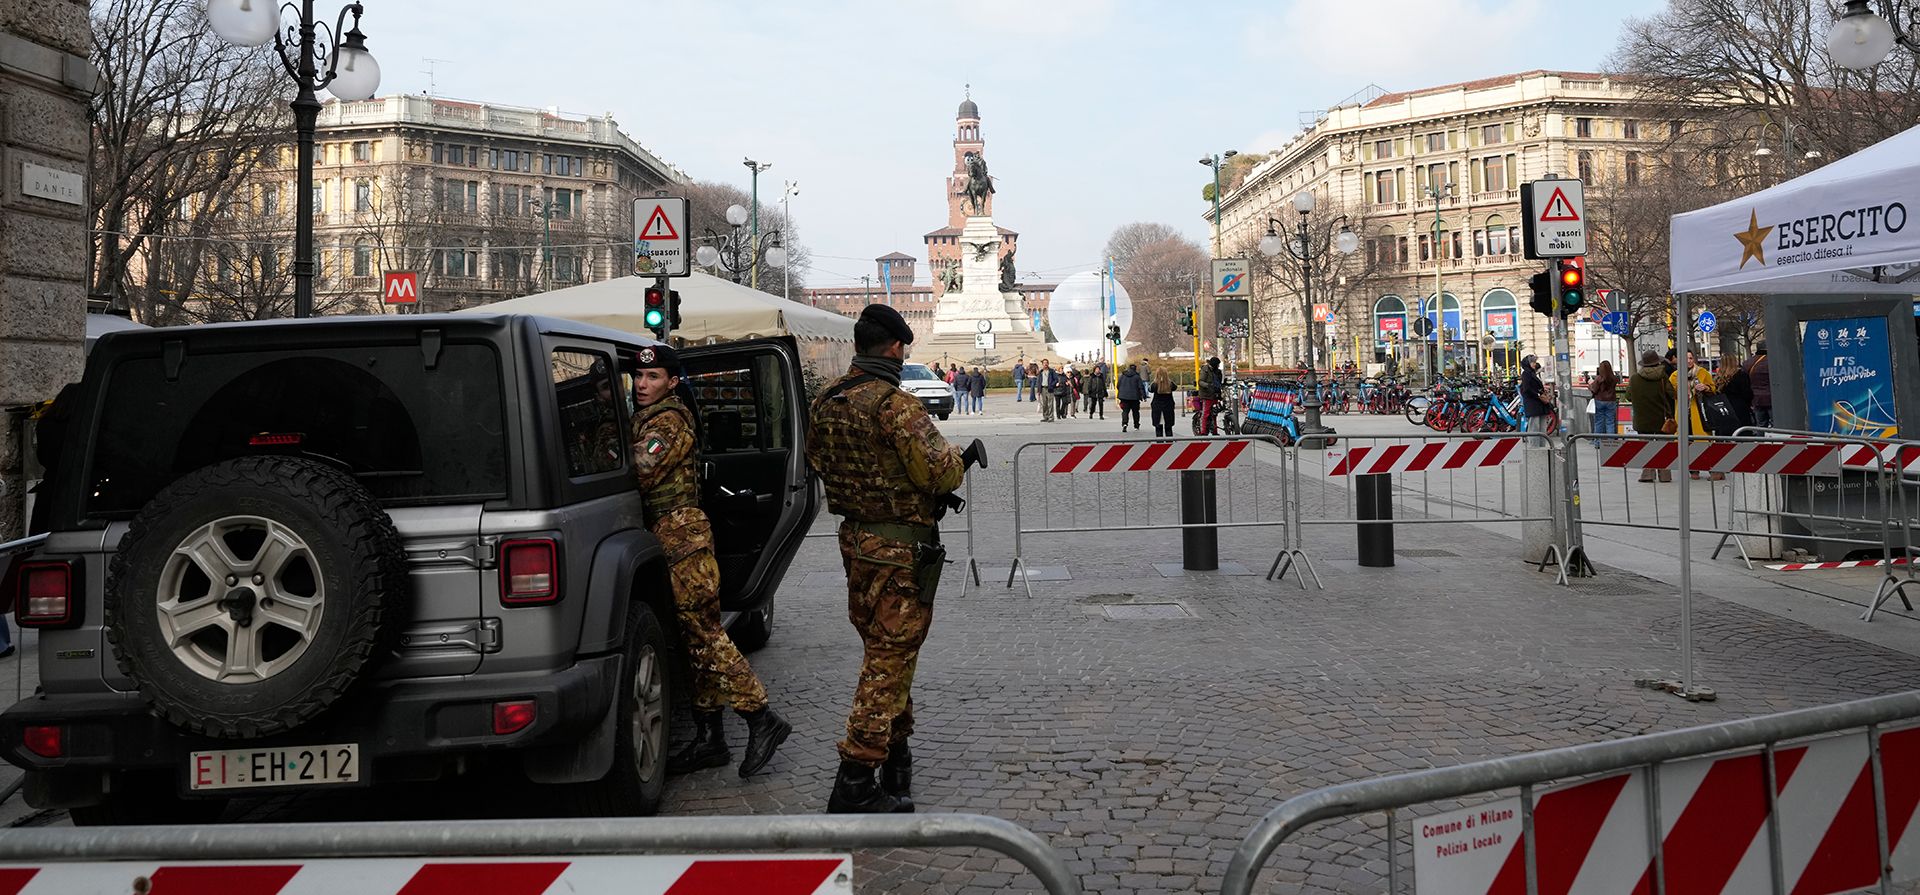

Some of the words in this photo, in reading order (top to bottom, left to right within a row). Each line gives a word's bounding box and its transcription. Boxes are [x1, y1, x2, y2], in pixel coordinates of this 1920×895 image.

[48, 171, 60, 180] VIA
[35, 181, 73, 197] DANTE
[1777, 202, 1907, 250] ESERCITO
[639, 247, 680, 257] ssuasori
[1776, 245, 1853, 266] esercito.difesa.it
[1833, 356, 1855, 367] IT'S
[1819, 366, 1865, 377] MILANO
[1838, 371, 1858, 385] your
[252, 752, 285, 782] EH
[299, 749, 352, 780] 212
[1422, 820, 1462, 838] Comune
[1466, 815, 1475, 828] di
[1480, 809, 1513, 825] Milano
[1436, 841, 1468, 858] Polizia
